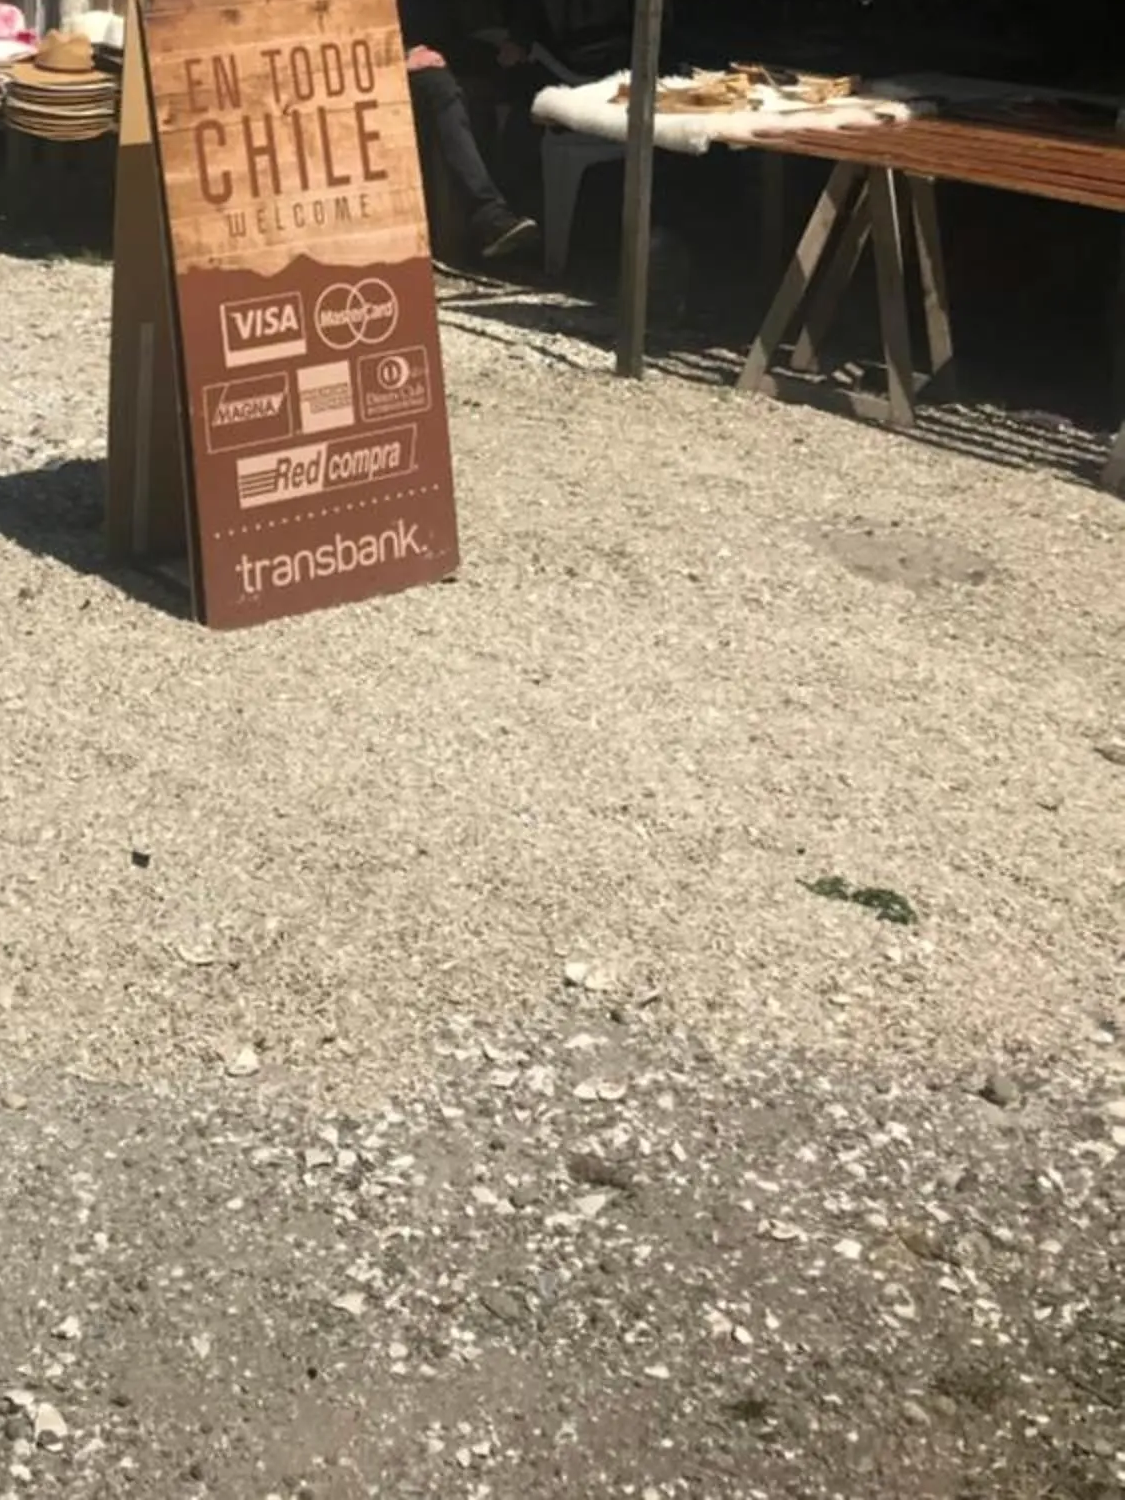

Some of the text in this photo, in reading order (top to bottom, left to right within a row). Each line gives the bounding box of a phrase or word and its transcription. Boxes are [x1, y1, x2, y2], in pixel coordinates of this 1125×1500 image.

[184, 39, 374, 113] EN TODO
[194, 100, 388, 205] CHILE
[227, 194, 371, 238] WELCOME
[230, 304, 299, 340] VISA
